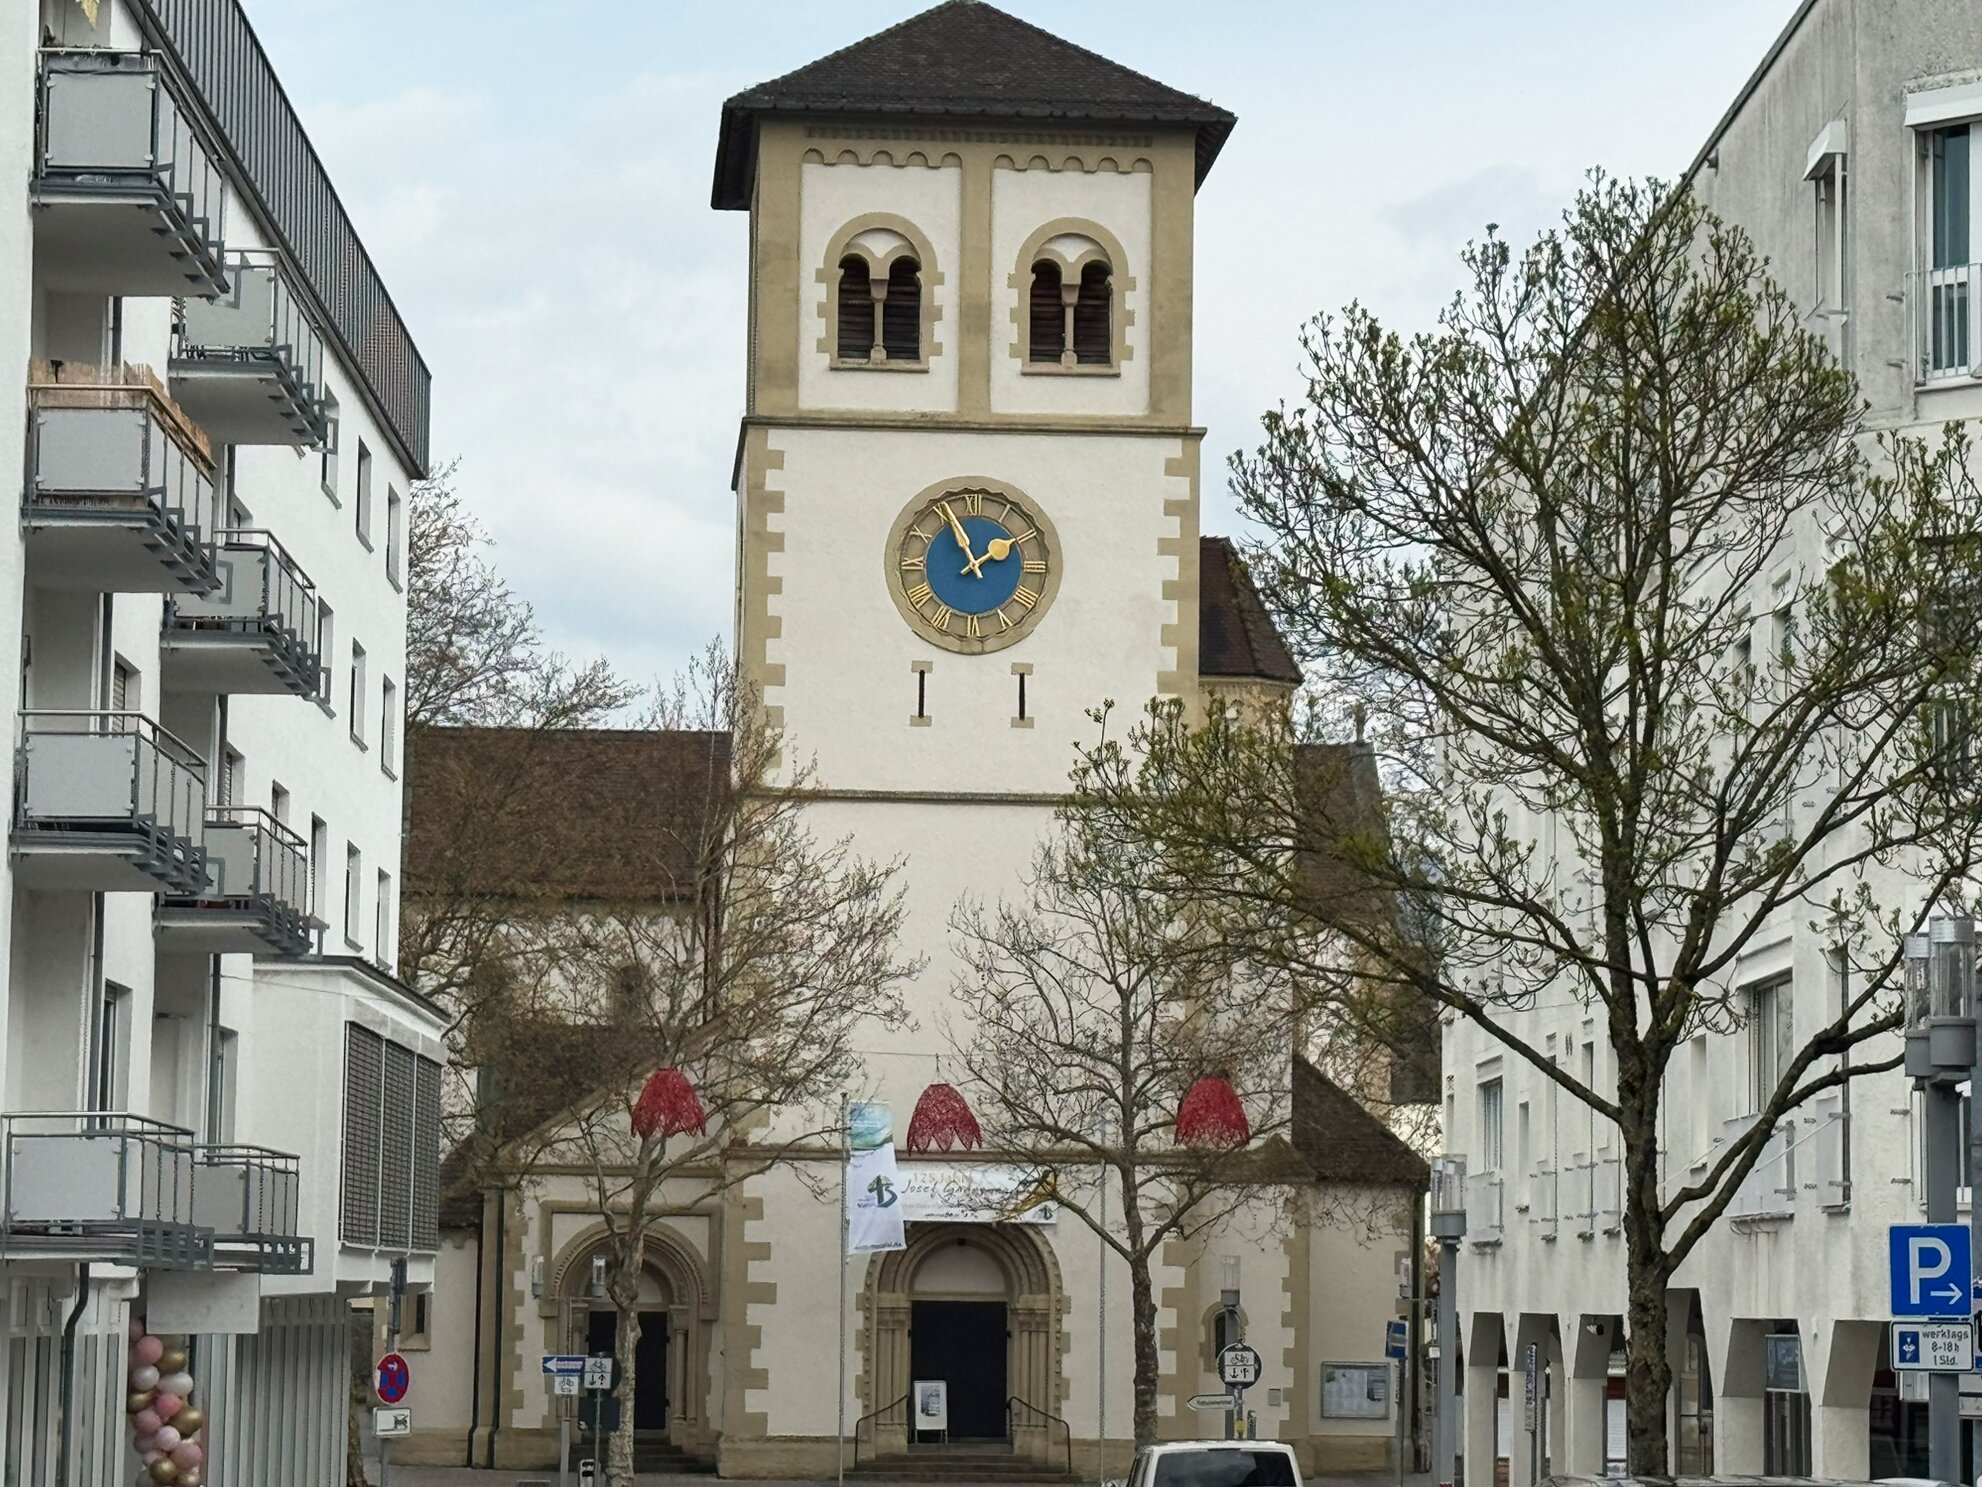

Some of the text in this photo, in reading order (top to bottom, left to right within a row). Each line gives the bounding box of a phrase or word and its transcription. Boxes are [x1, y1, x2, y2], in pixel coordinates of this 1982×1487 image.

[965, 494, 982, 517] XII
[909, 525, 933, 543] X
[1016, 528, 1037, 543] II
[1023, 561, 1046, 573] III
[967, 615, 980, 637] VI
[997, 609, 1013, 630] V
[1909, 1237, 1951, 1304] P
